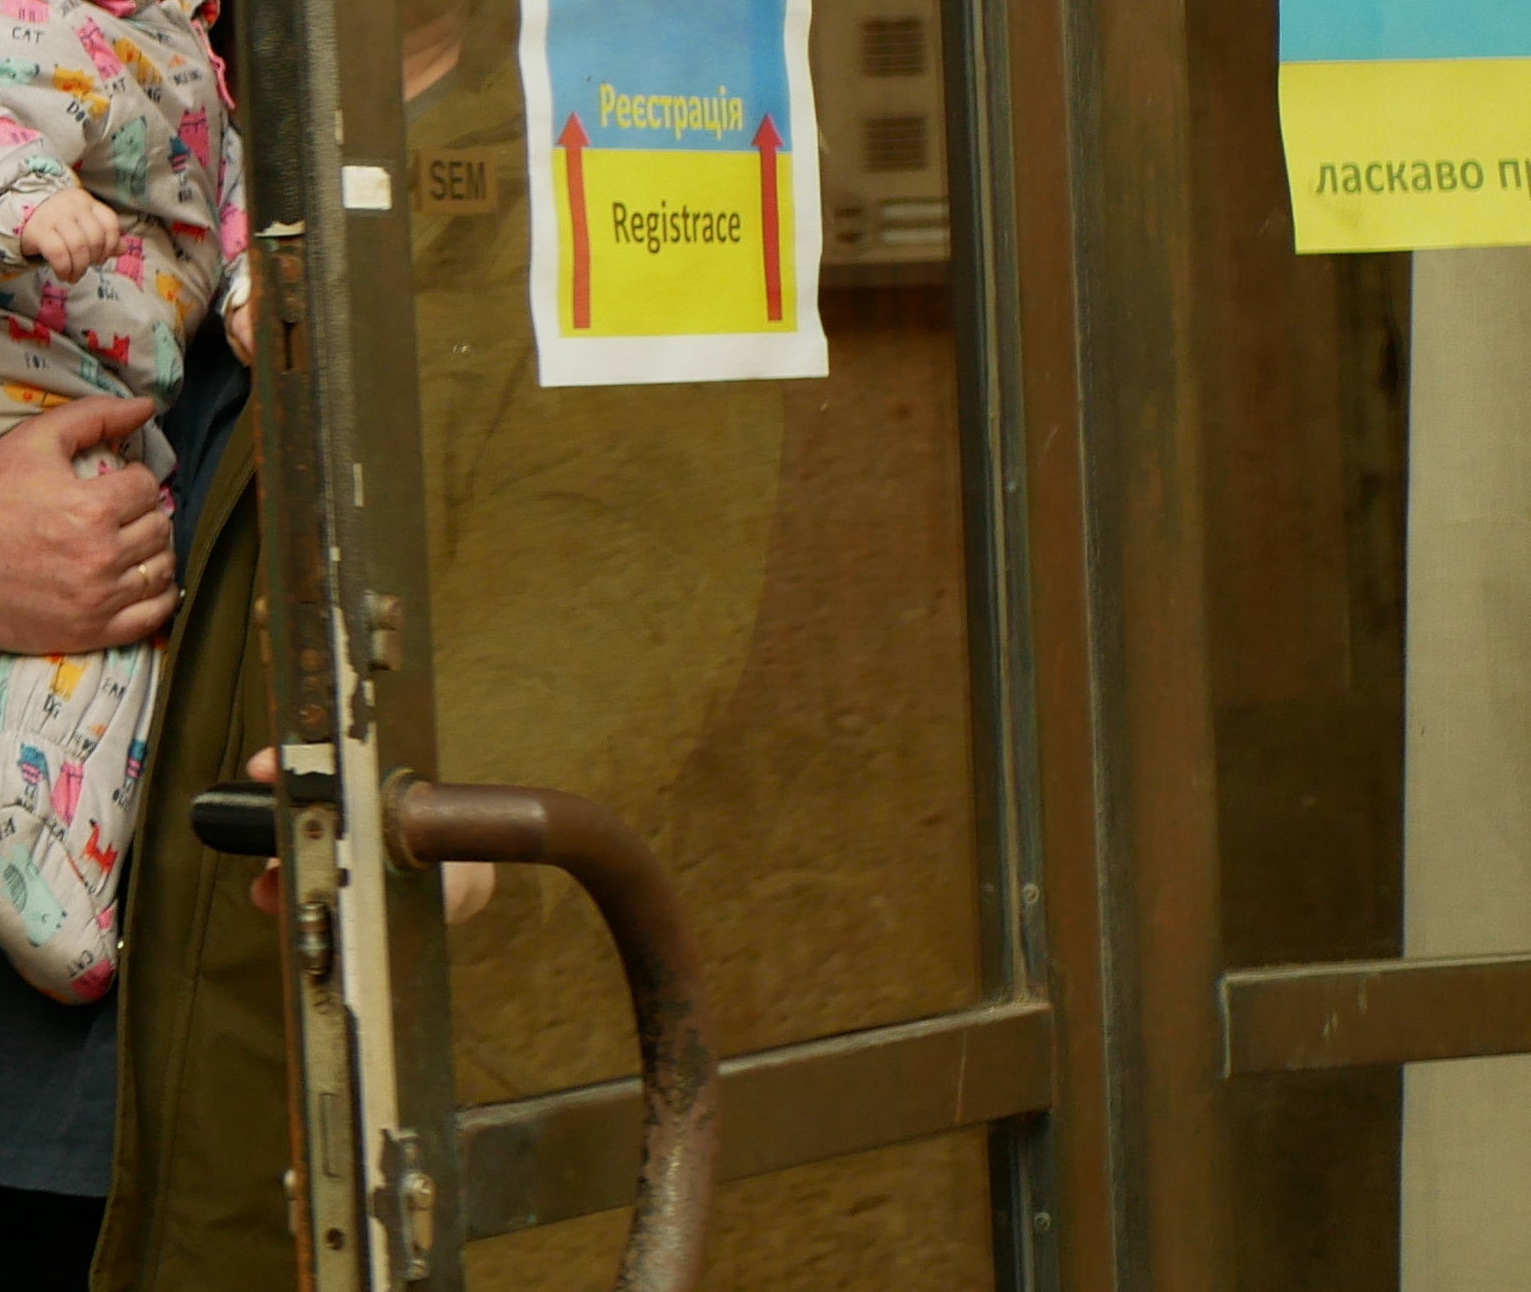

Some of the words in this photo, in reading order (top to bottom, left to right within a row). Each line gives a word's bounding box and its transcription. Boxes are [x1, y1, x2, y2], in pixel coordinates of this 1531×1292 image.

[11, 26, 46, 44] CAT
[599, 82, 745, 141] Реєстрація
[429, 160, 488, 202] SEM
[1315, 158, 1485, 195] ласкаво
[612, 200, 742, 254] Registrace
